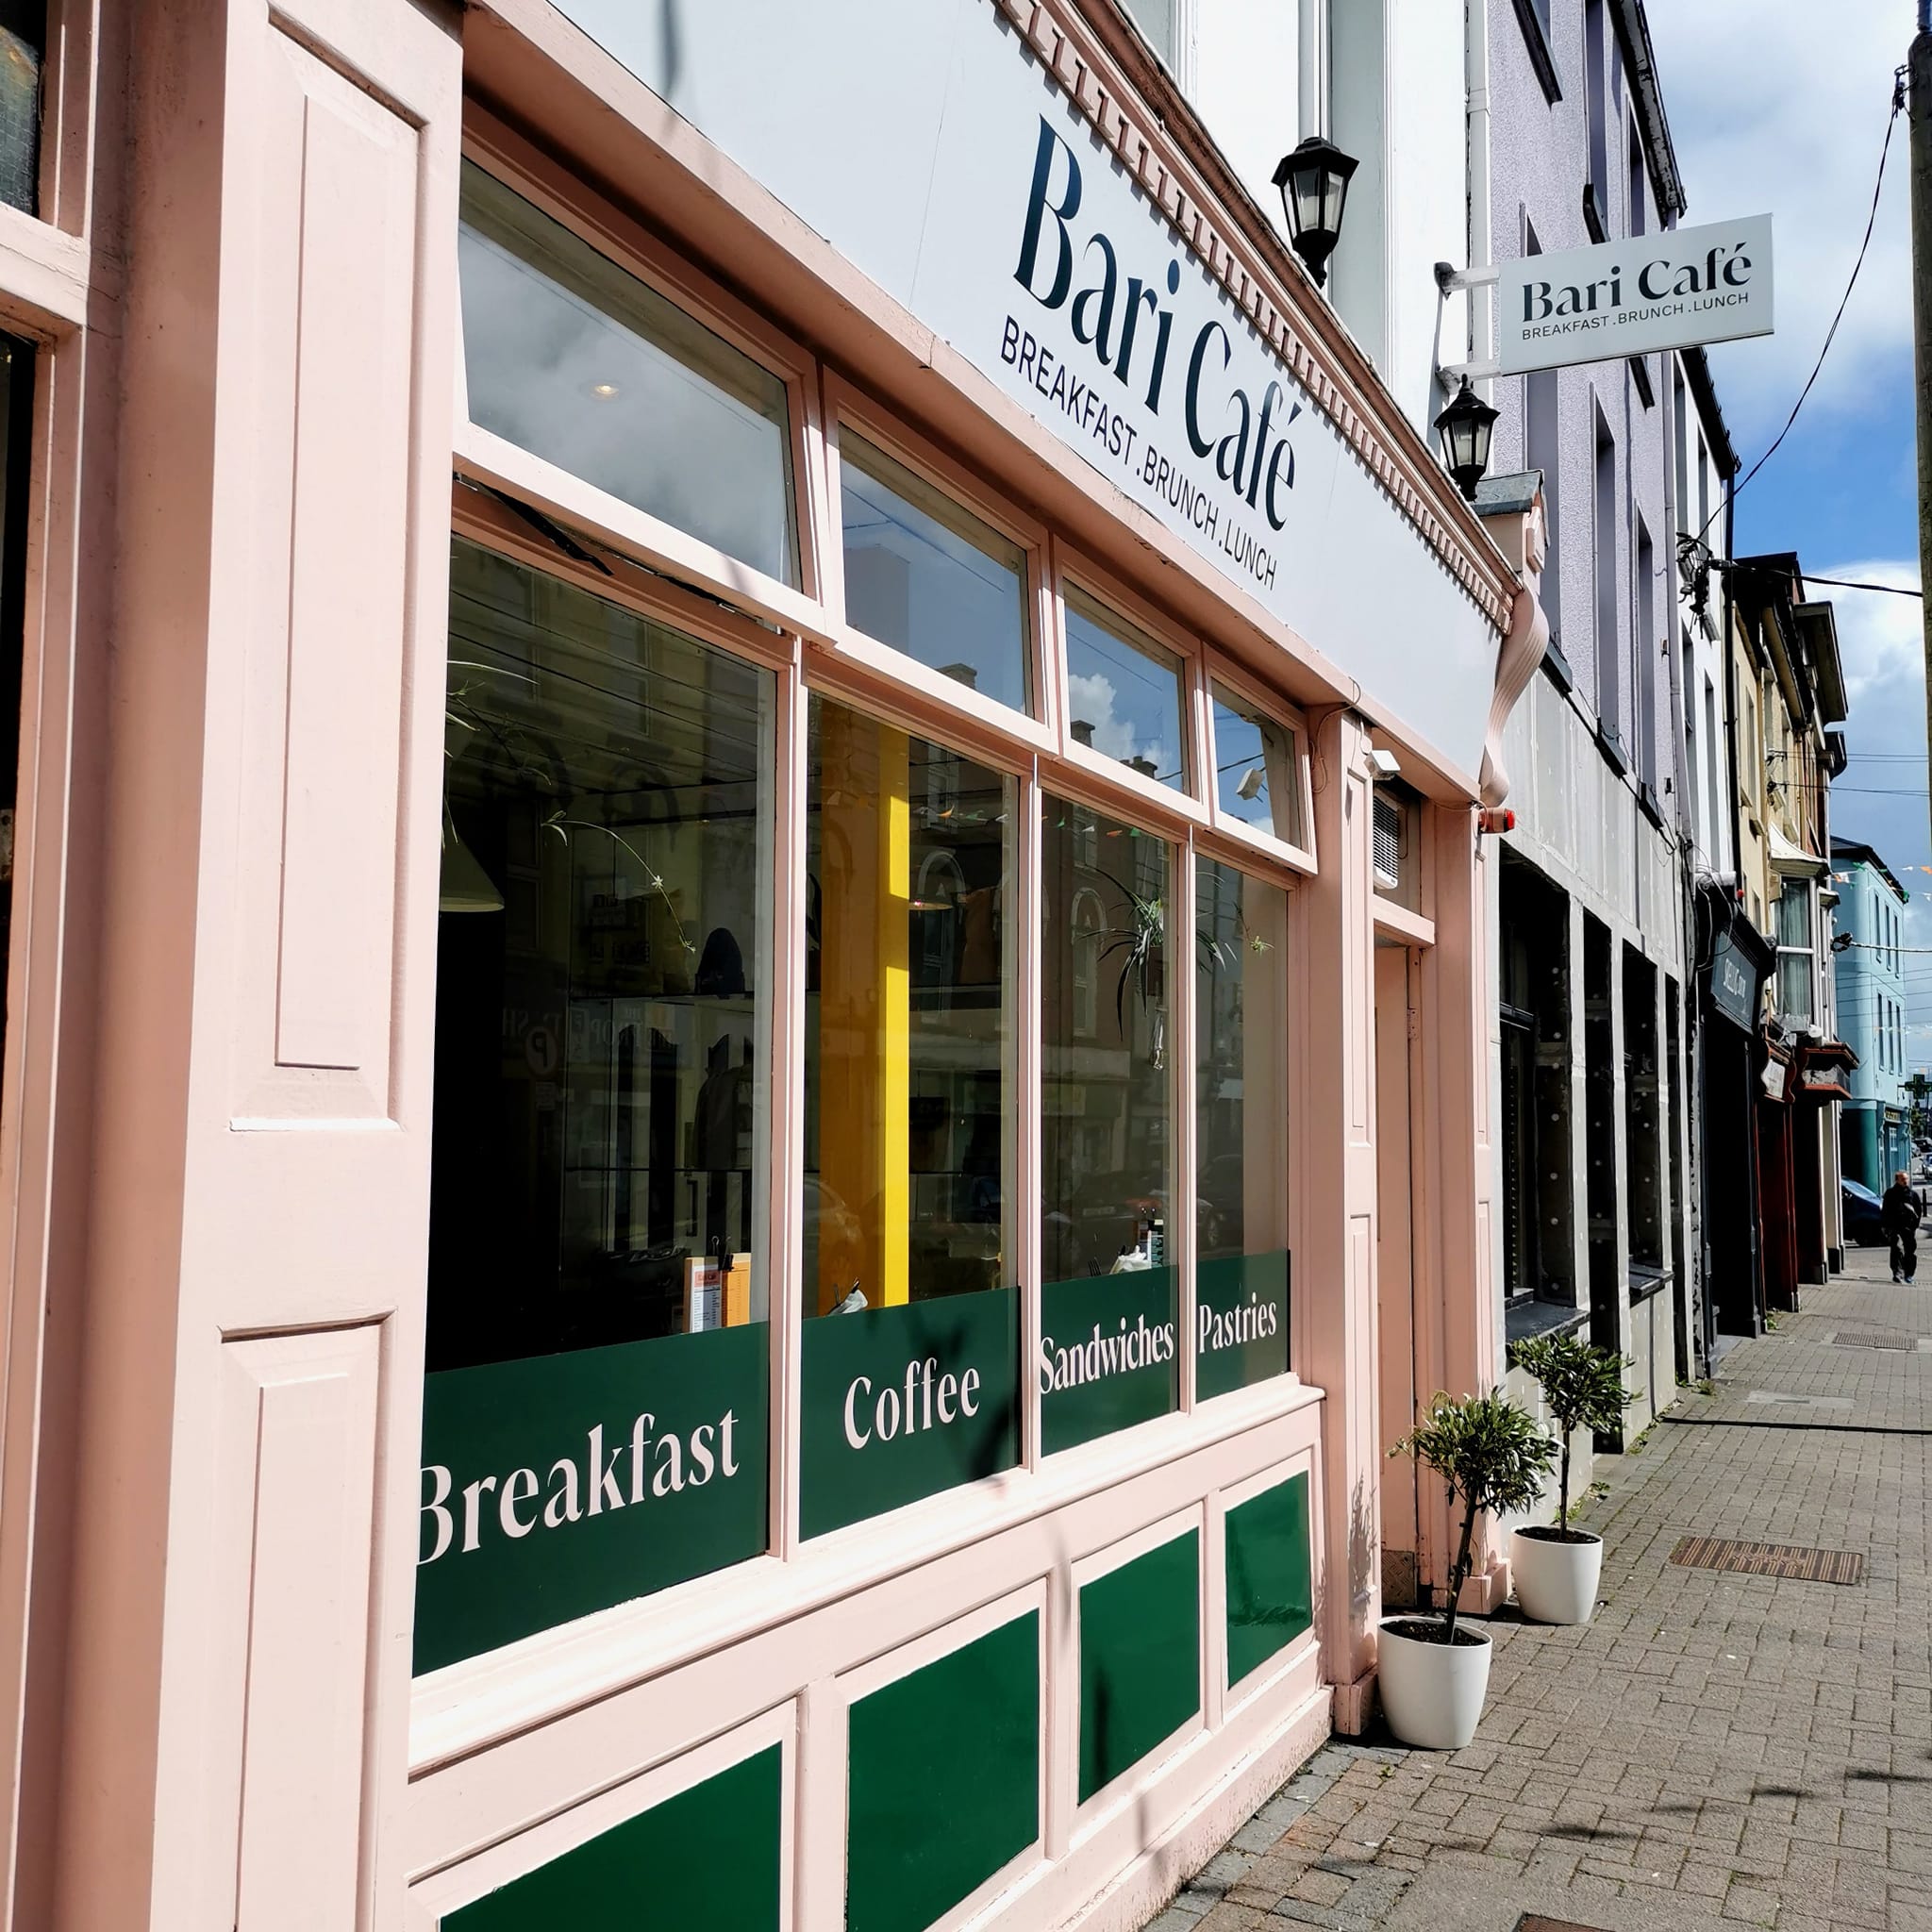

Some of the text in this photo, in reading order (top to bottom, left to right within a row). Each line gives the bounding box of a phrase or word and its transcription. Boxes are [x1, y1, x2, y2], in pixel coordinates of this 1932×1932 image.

[1013, 113, 1302, 531] Bari Café
[1523, 242, 1752, 323] Bari Café
[1523, 315, 1609, 341] BREAKFAST
[1001, 315, 1138, 466] BREAKFAST
[1040, 1314, 1174, 1395] Sandwiches
[1198, 1291, 1278, 1356] Pastries
[844, 1357, 981, 1451] Coffee
[418, 1408, 741, 1565] Breakfast
